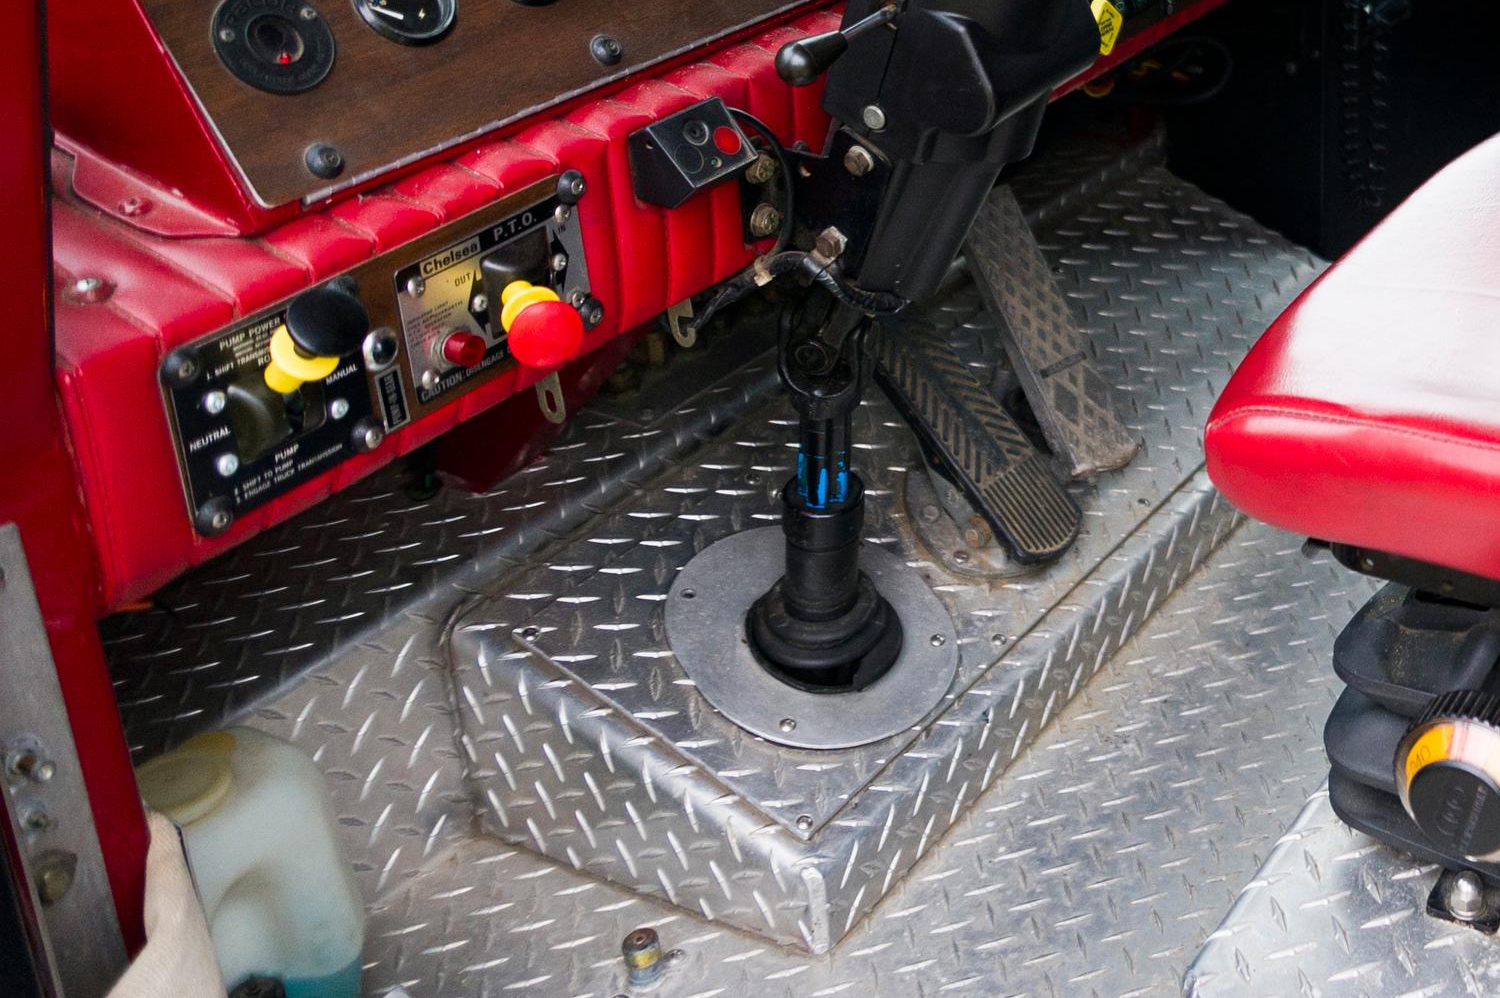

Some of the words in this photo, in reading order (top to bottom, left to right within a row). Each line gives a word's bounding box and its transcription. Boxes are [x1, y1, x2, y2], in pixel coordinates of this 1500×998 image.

[422, 243, 479, 275] Chelsea
[493, 211, 537, 242] P.T.O.
[454, 272, 472, 288] OUT
[219, 332, 246, 351] PUMP
[249, 317, 281, 338] POWER
[214, 362, 235, 377] SHIFT
[325, 363, 359, 386] MANUAL
[189, 425, 232, 453] NEUTRAL
[274, 443, 300, 463] PUMP
[242, 476, 262, 492] SHIFT
[264, 470, 274, 480] TO
[275, 459, 294, 474] PUMP
